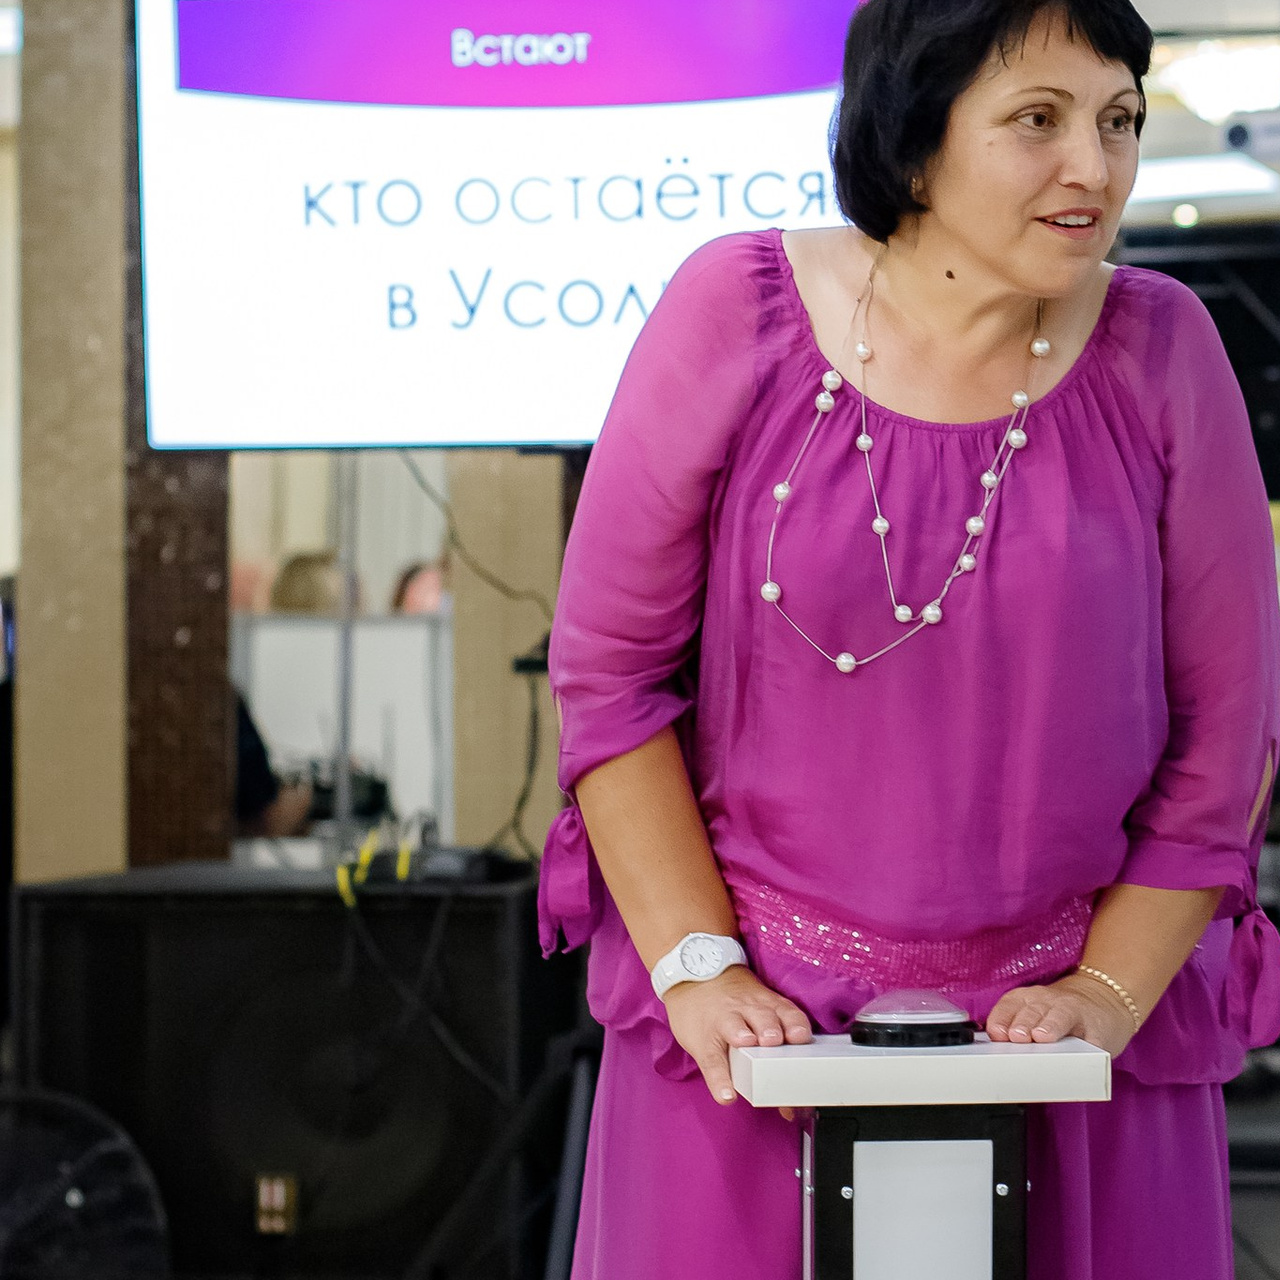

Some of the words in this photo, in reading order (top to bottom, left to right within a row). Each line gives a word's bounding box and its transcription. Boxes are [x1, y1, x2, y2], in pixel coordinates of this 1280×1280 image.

[451, 28, 592, 68] Встают
[303, 179, 422, 227] кто
[455, 157, 825, 225] остаётся
[388, 283, 417, 330] в
[449, 267, 669, 330] Усол
